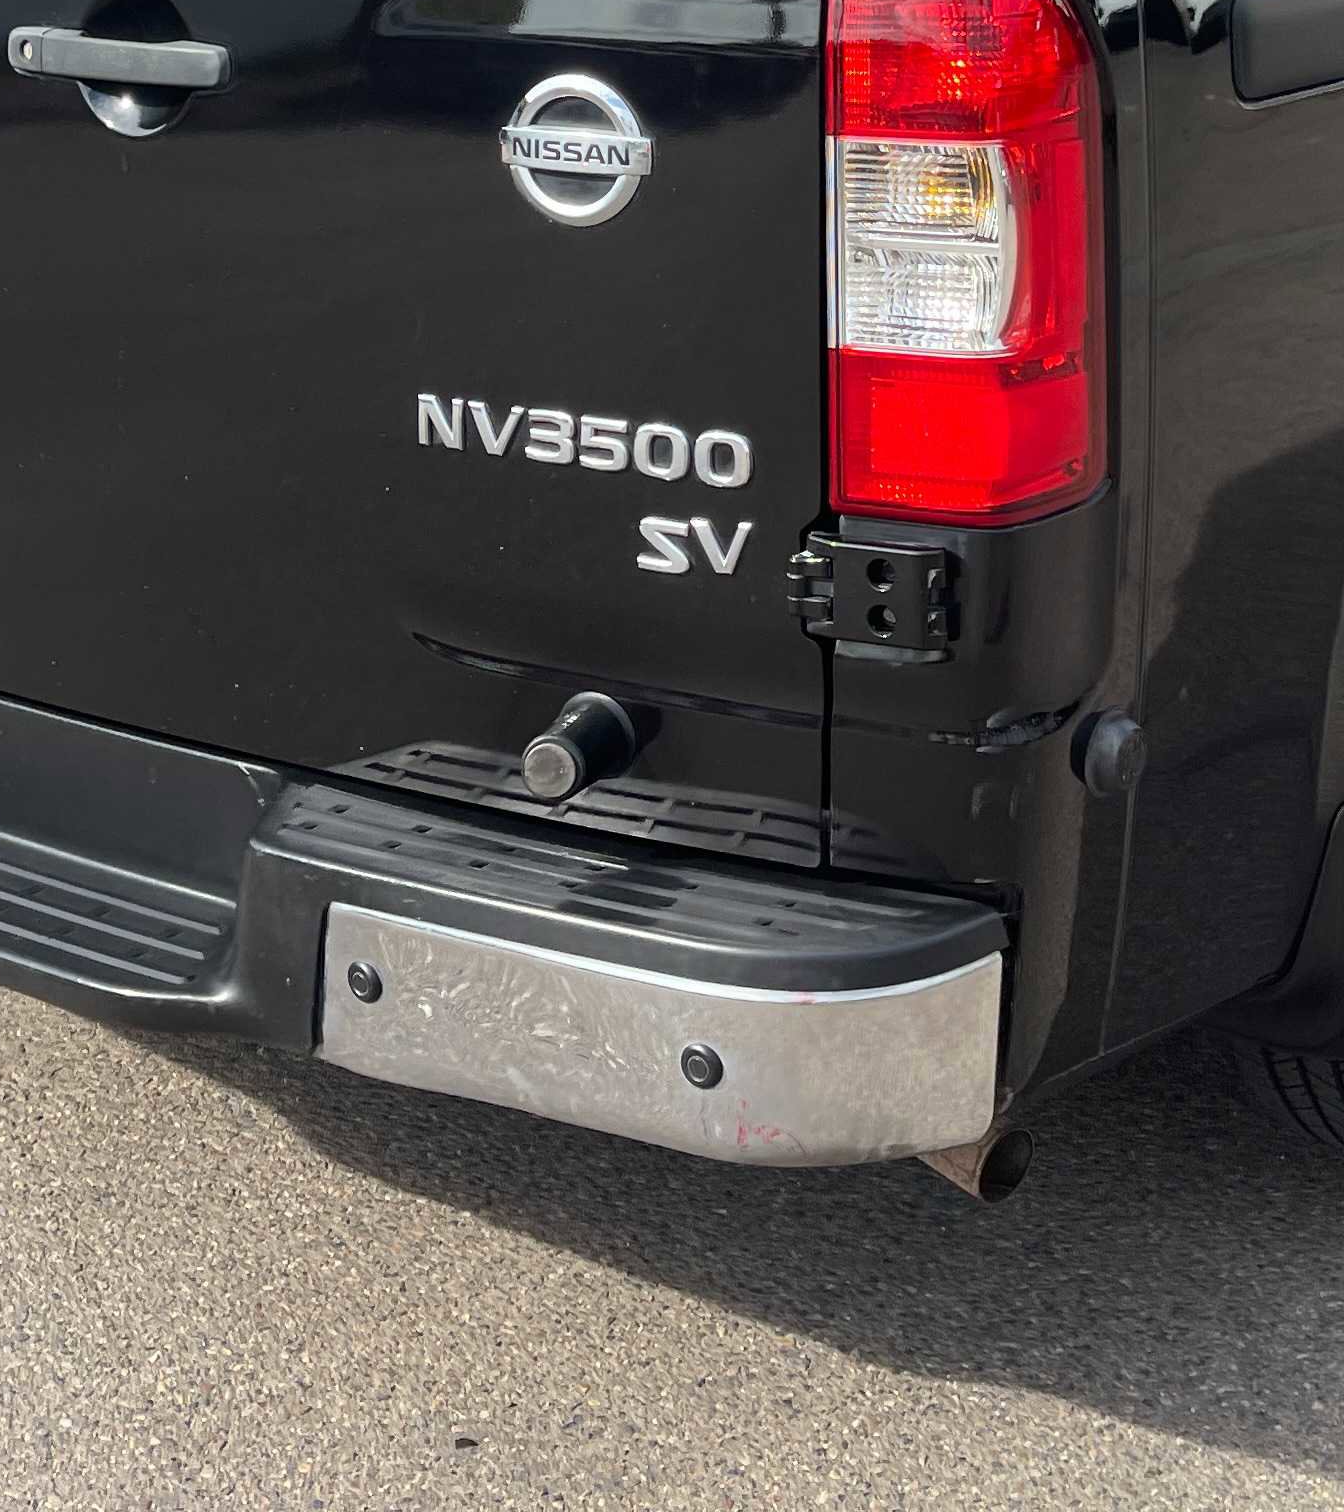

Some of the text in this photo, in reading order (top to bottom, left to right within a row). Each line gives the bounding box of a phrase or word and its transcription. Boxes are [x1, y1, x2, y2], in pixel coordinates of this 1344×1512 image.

[511, 136, 631, 168] NISSAN
[417, 393, 754, 488] NV3500
[636, 516, 753, 576] SV
